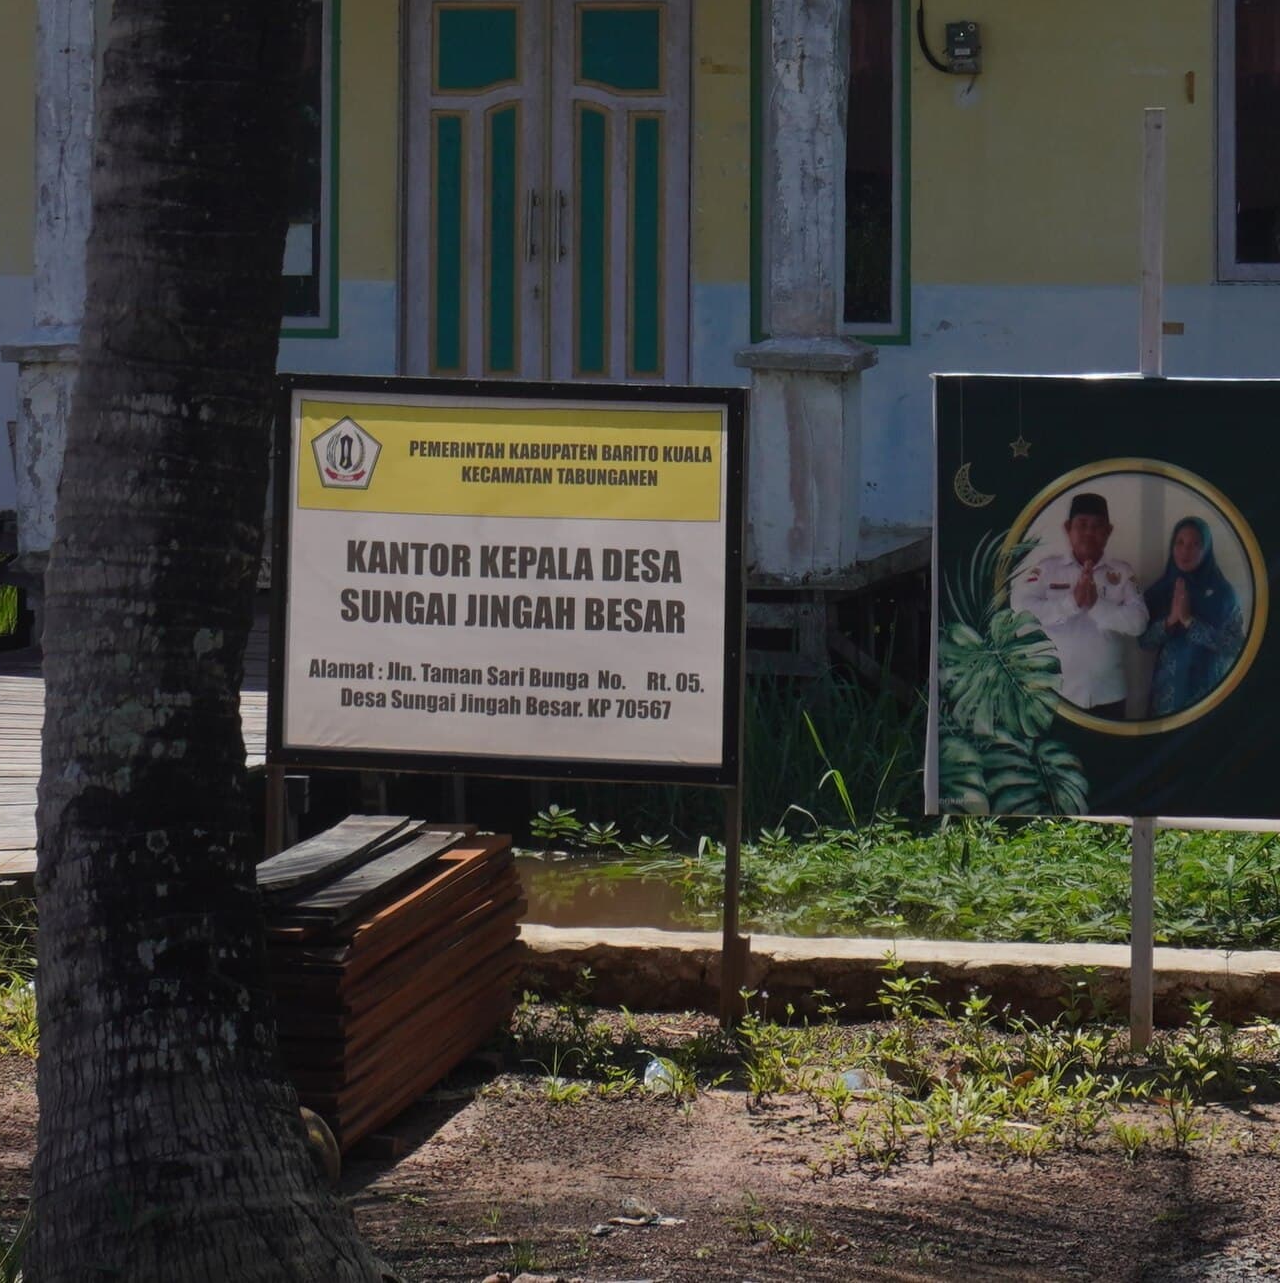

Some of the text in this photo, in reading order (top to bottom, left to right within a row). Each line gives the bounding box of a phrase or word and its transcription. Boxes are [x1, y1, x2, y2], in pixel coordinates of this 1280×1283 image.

[409, 440, 506, 460] PEMERINTAH
[509, 442, 598, 461] KABUPATEN
[662, 445, 713, 463] KUALA
[461, 465, 658, 487] KECAMATAN TABUNGANEN
[346, 539, 682, 584] KANTOR KEPALA DESA
[340, 588, 686, 634] SUNGAI JINGAH BESAR
[308, 658, 375, 680] Alamat
[386, 661, 417, 682] Jln.
[420, 663, 483, 686] Taman
[486, 665, 525, 687] Sari
[529, 667, 589, 692] Bunga
[597, 669, 626, 690] No.
[647, 671, 672, 692] Rt.
[675, 672, 705, 693] 05.
[340, 687, 672, 720] Desa Sungai Jingah Besar. KP 70567
